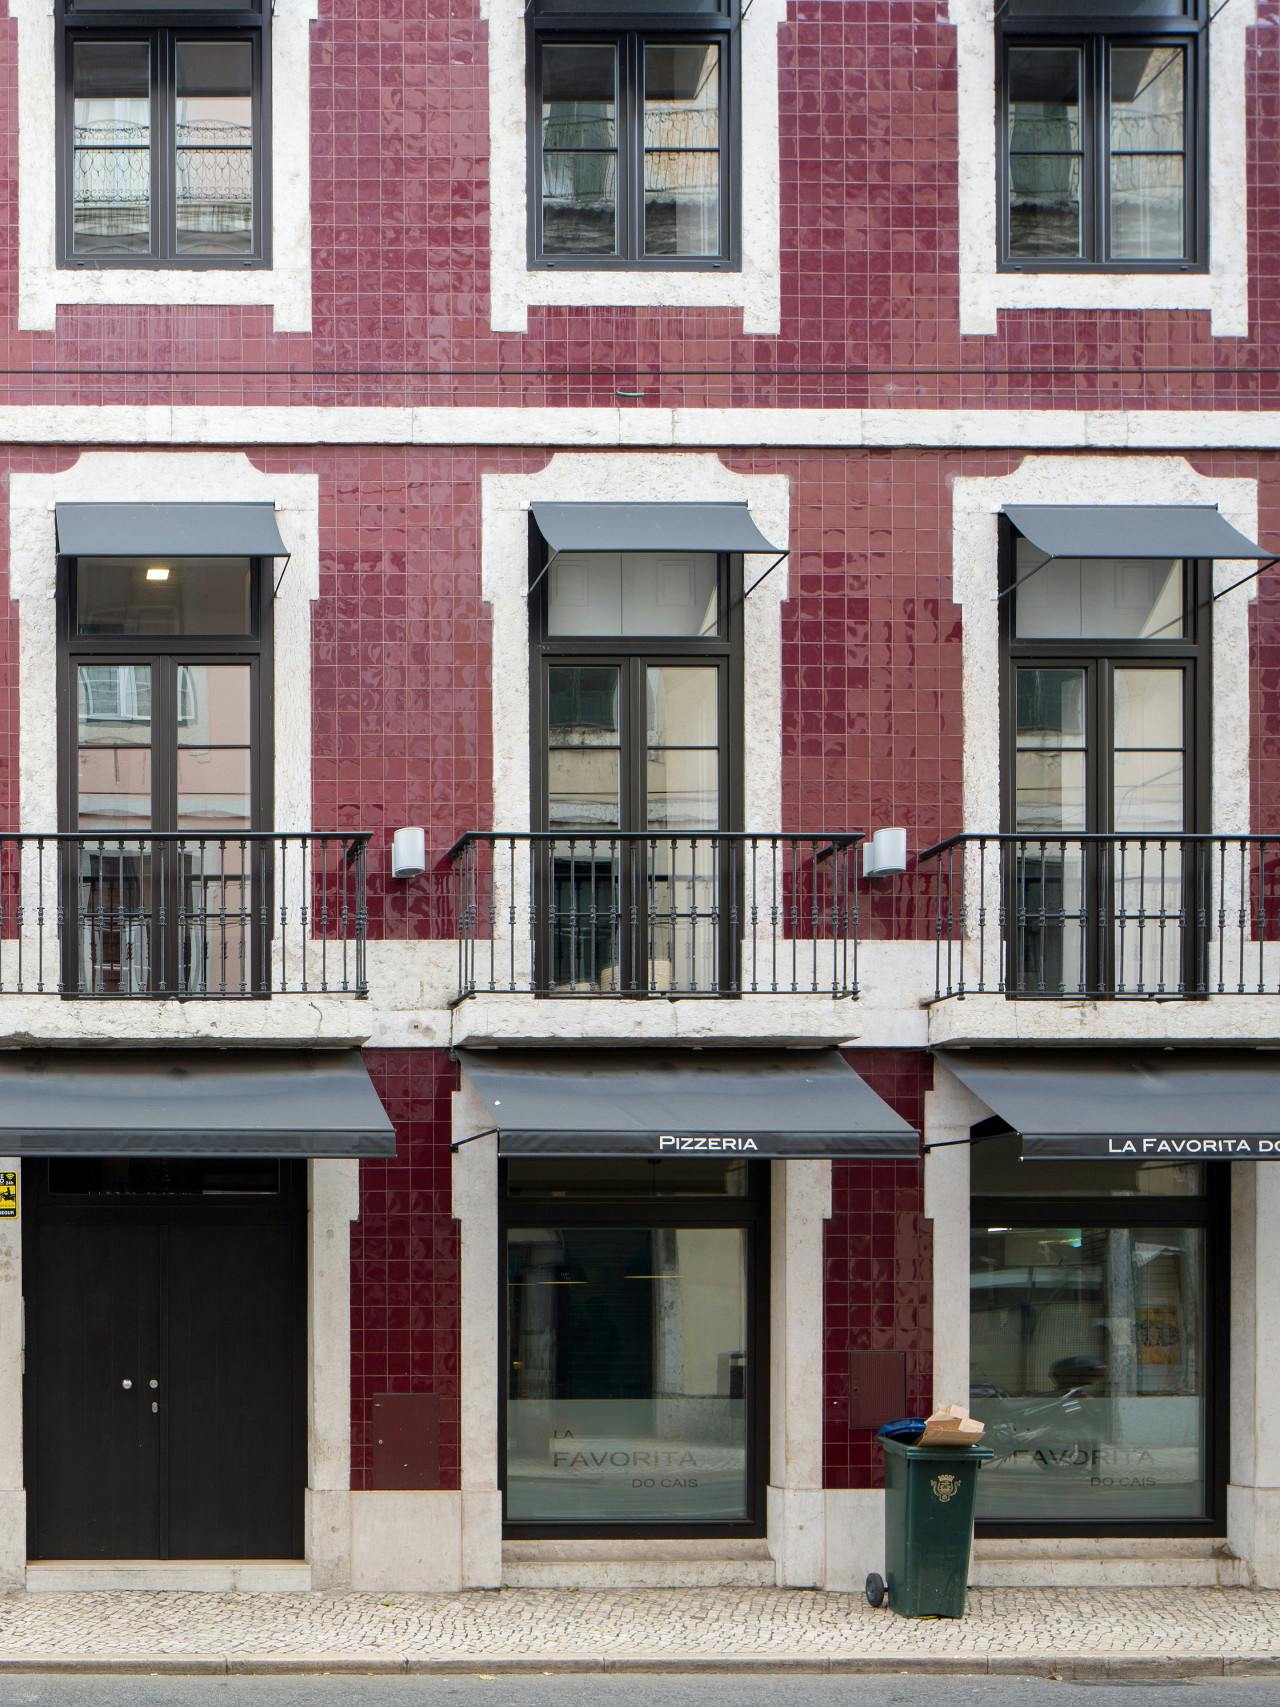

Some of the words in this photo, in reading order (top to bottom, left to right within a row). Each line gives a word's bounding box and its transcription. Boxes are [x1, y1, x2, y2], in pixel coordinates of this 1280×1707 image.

[659, 1135, 758, 1150] PIZZERIA
[1108, 1138, 1137, 1152] LA
[1142, 1138, 1251, 1152] FAVORITA
[553, 1430, 575, 1440] LA
[553, 1451, 697, 1467] FAVORITA
[632, 1479, 655, 1488] DO
[660, 1478, 699, 1488] CAIS
[1090, 1477, 1114, 1487] DO
[1118, 1476, 1157, 1487] CAIS
